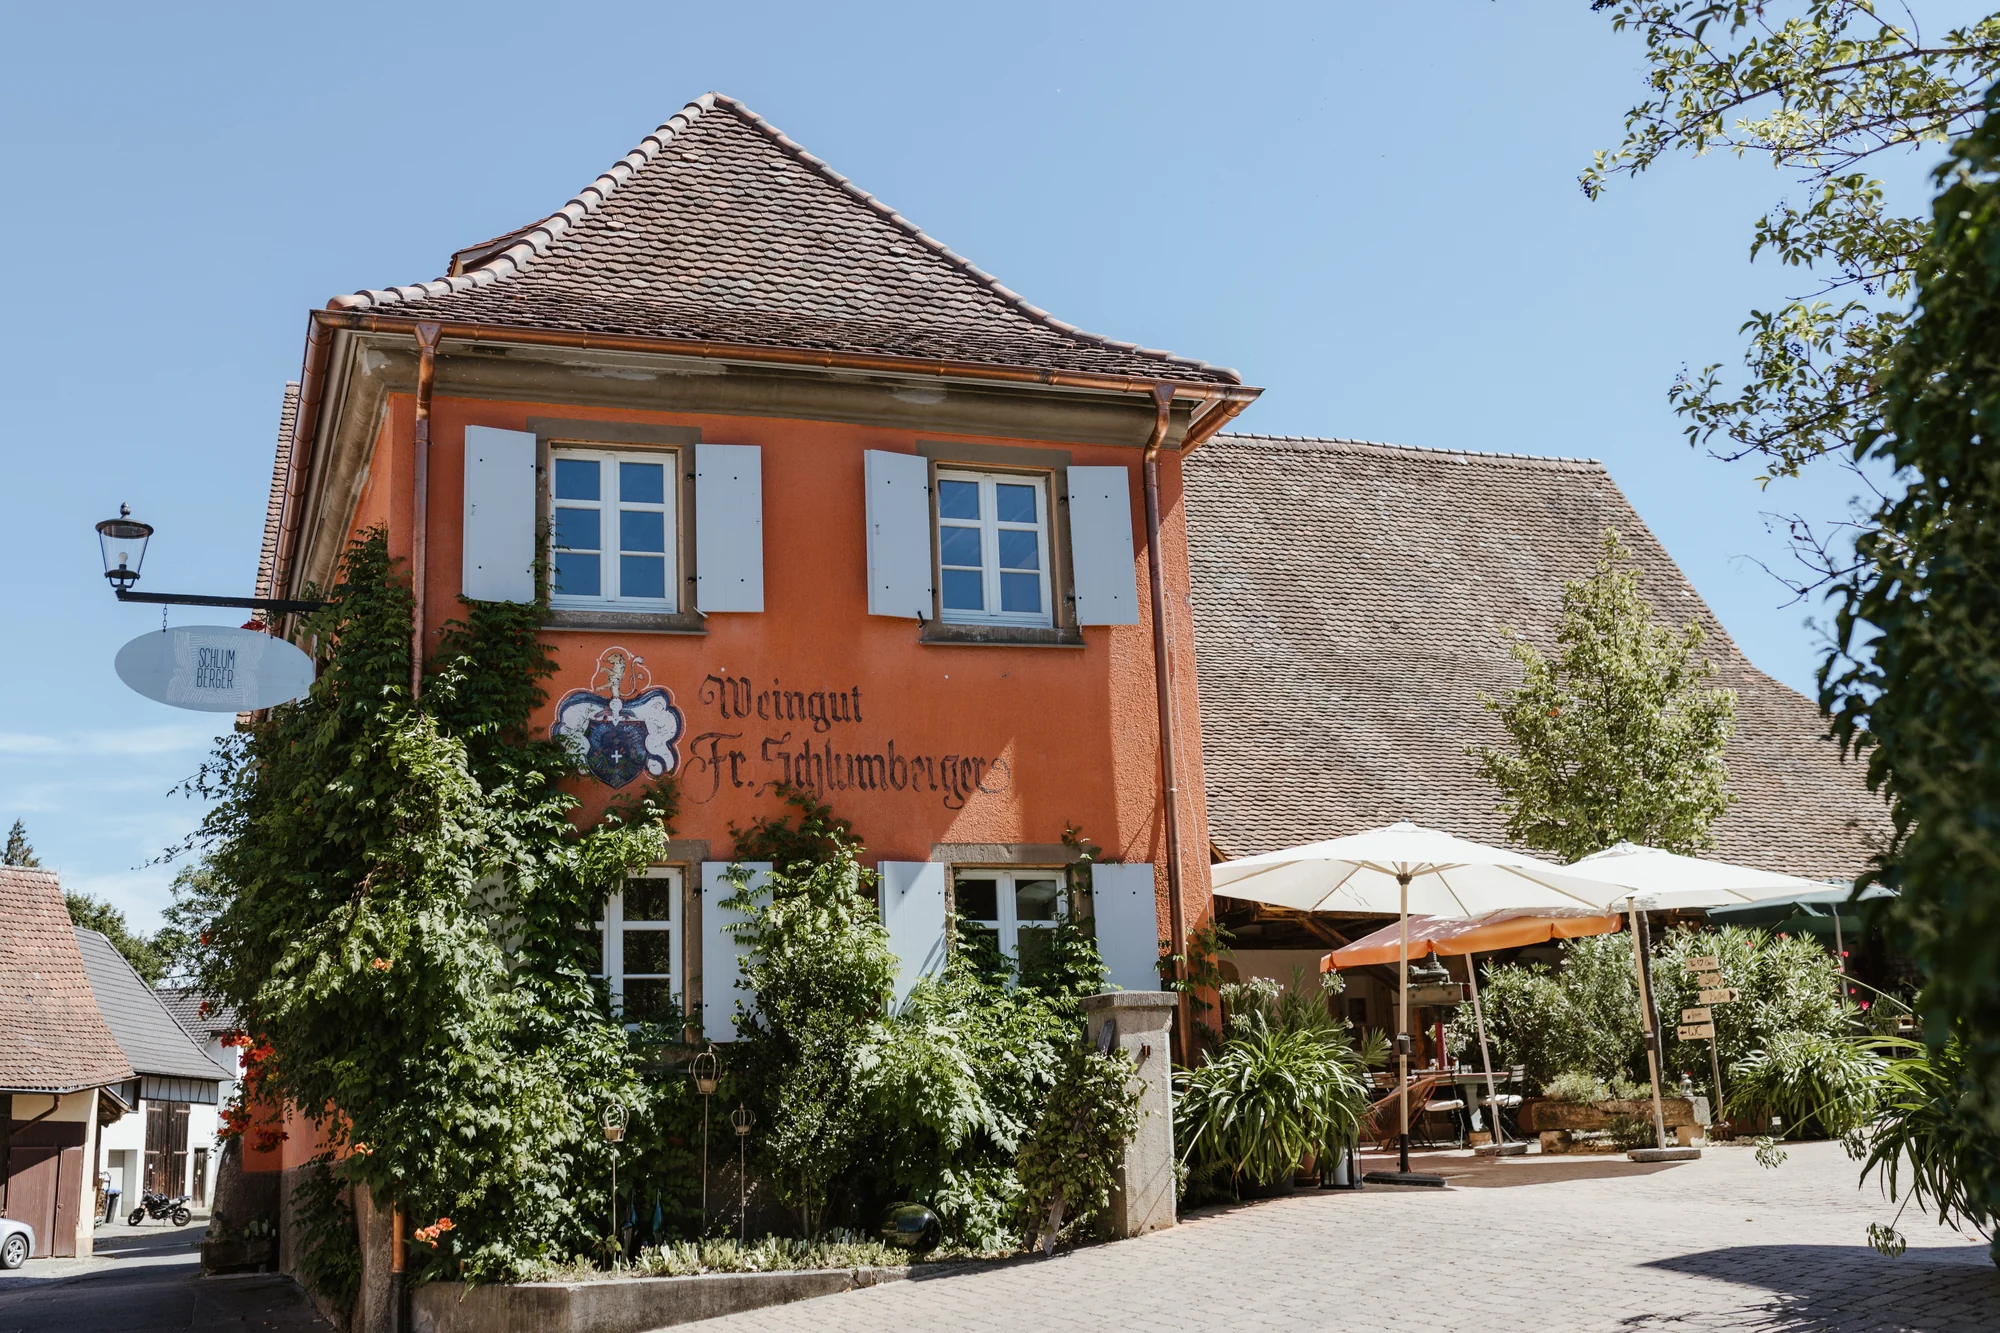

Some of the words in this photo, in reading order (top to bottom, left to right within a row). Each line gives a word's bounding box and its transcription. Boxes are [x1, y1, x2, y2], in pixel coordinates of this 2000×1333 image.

[199, 648, 235, 669] SCHLUM
[197, 668, 234, 689] BERGER
[698, 674, 863, 733] Weingut
[681, 732, 755, 804] Fr.
[755, 732, 1011, 810] Schlumberger
[1687, 1025, 1703, 1036] WC
